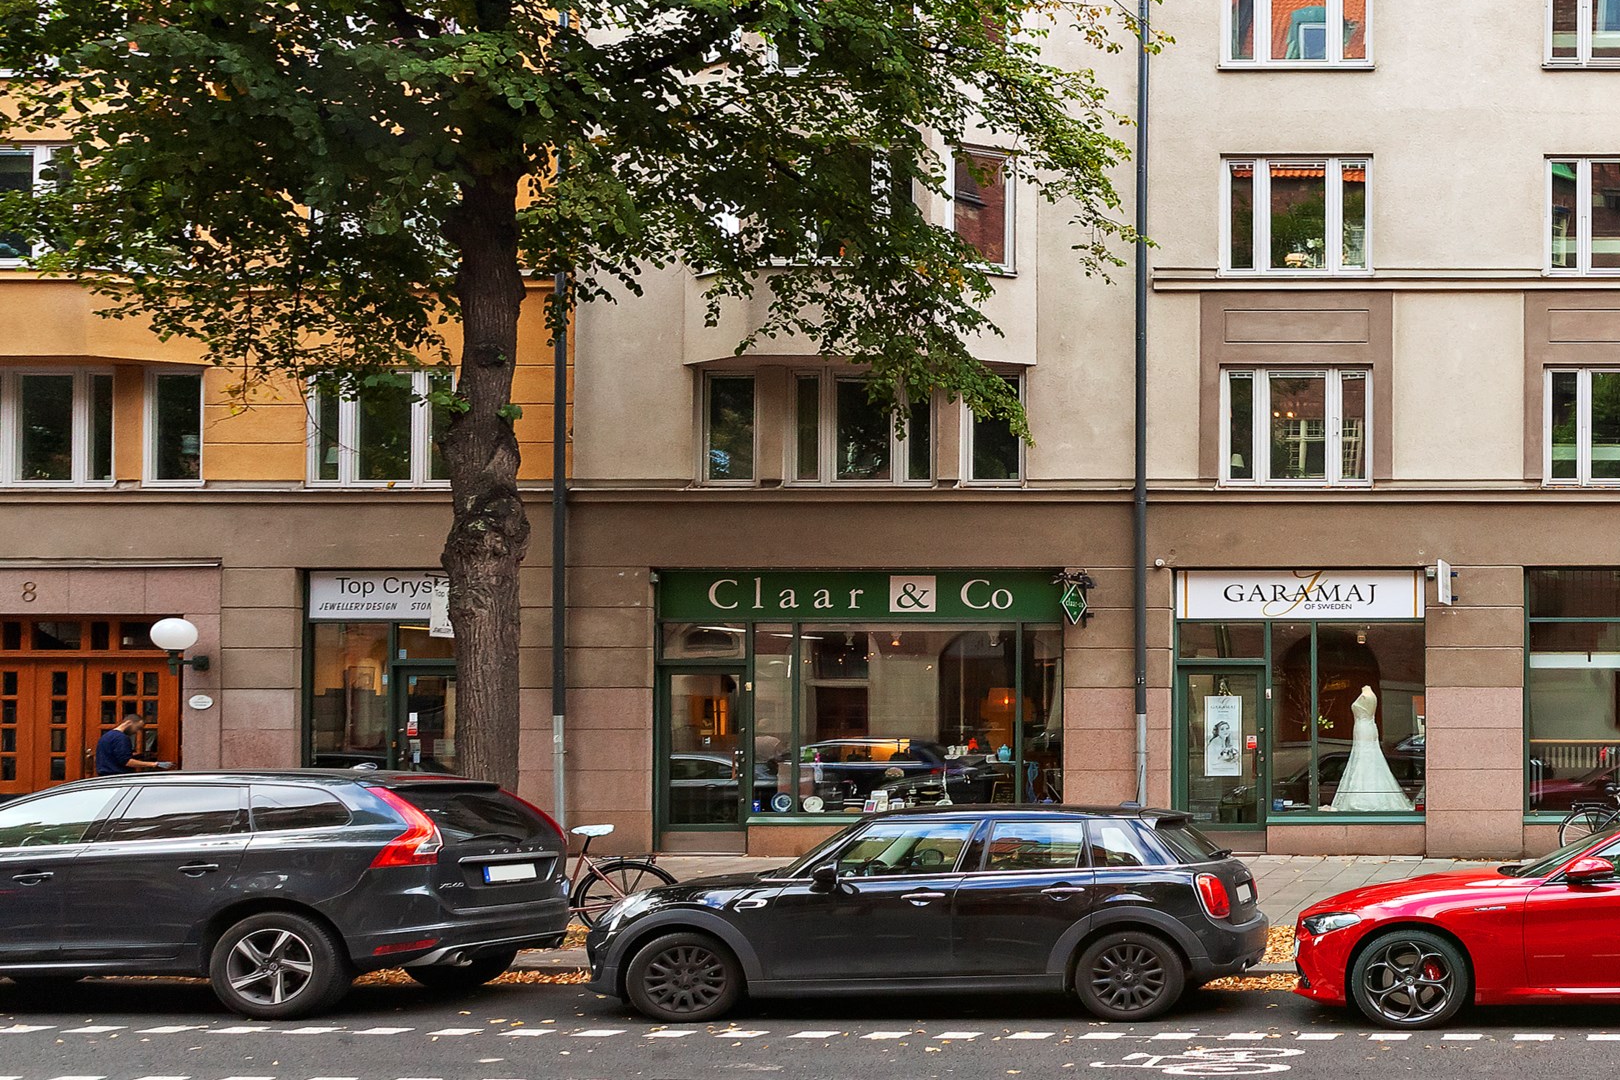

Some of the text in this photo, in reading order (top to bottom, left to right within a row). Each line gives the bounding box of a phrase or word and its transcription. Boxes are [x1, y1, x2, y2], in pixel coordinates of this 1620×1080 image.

[21, 581, 37, 603] 8
[336, 577, 375, 598] Top
[707, 576, 1014, 610] Claar & Co
[1223, 584, 1378, 606] GARAMAJ
[319, 602, 366, 611] JEWELLERY
[366, 602, 398, 611] DESIGN
